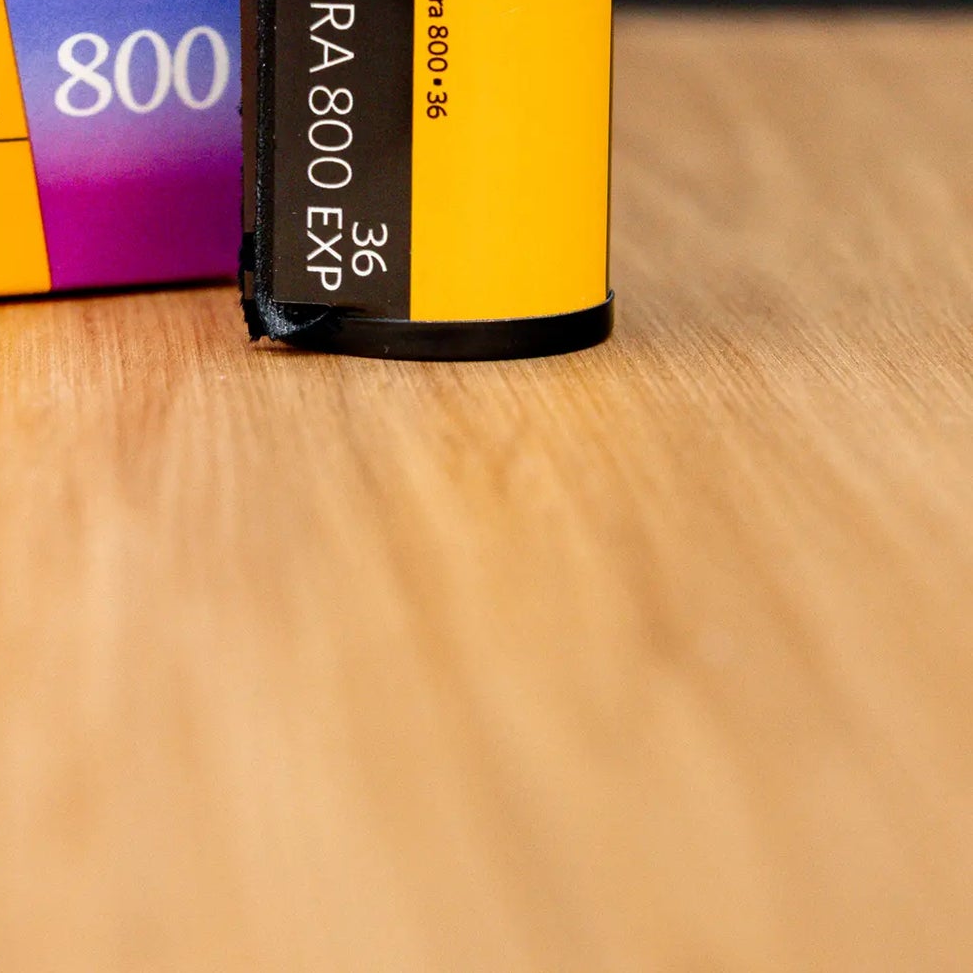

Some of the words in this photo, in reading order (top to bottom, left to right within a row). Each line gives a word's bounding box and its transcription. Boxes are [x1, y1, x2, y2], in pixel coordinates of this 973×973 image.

[54, 26, 229, 117] 800
[307, 86, 354, 189] 800
[306, 206, 343, 291] EXP
[351, 221, 388, 277] 36
